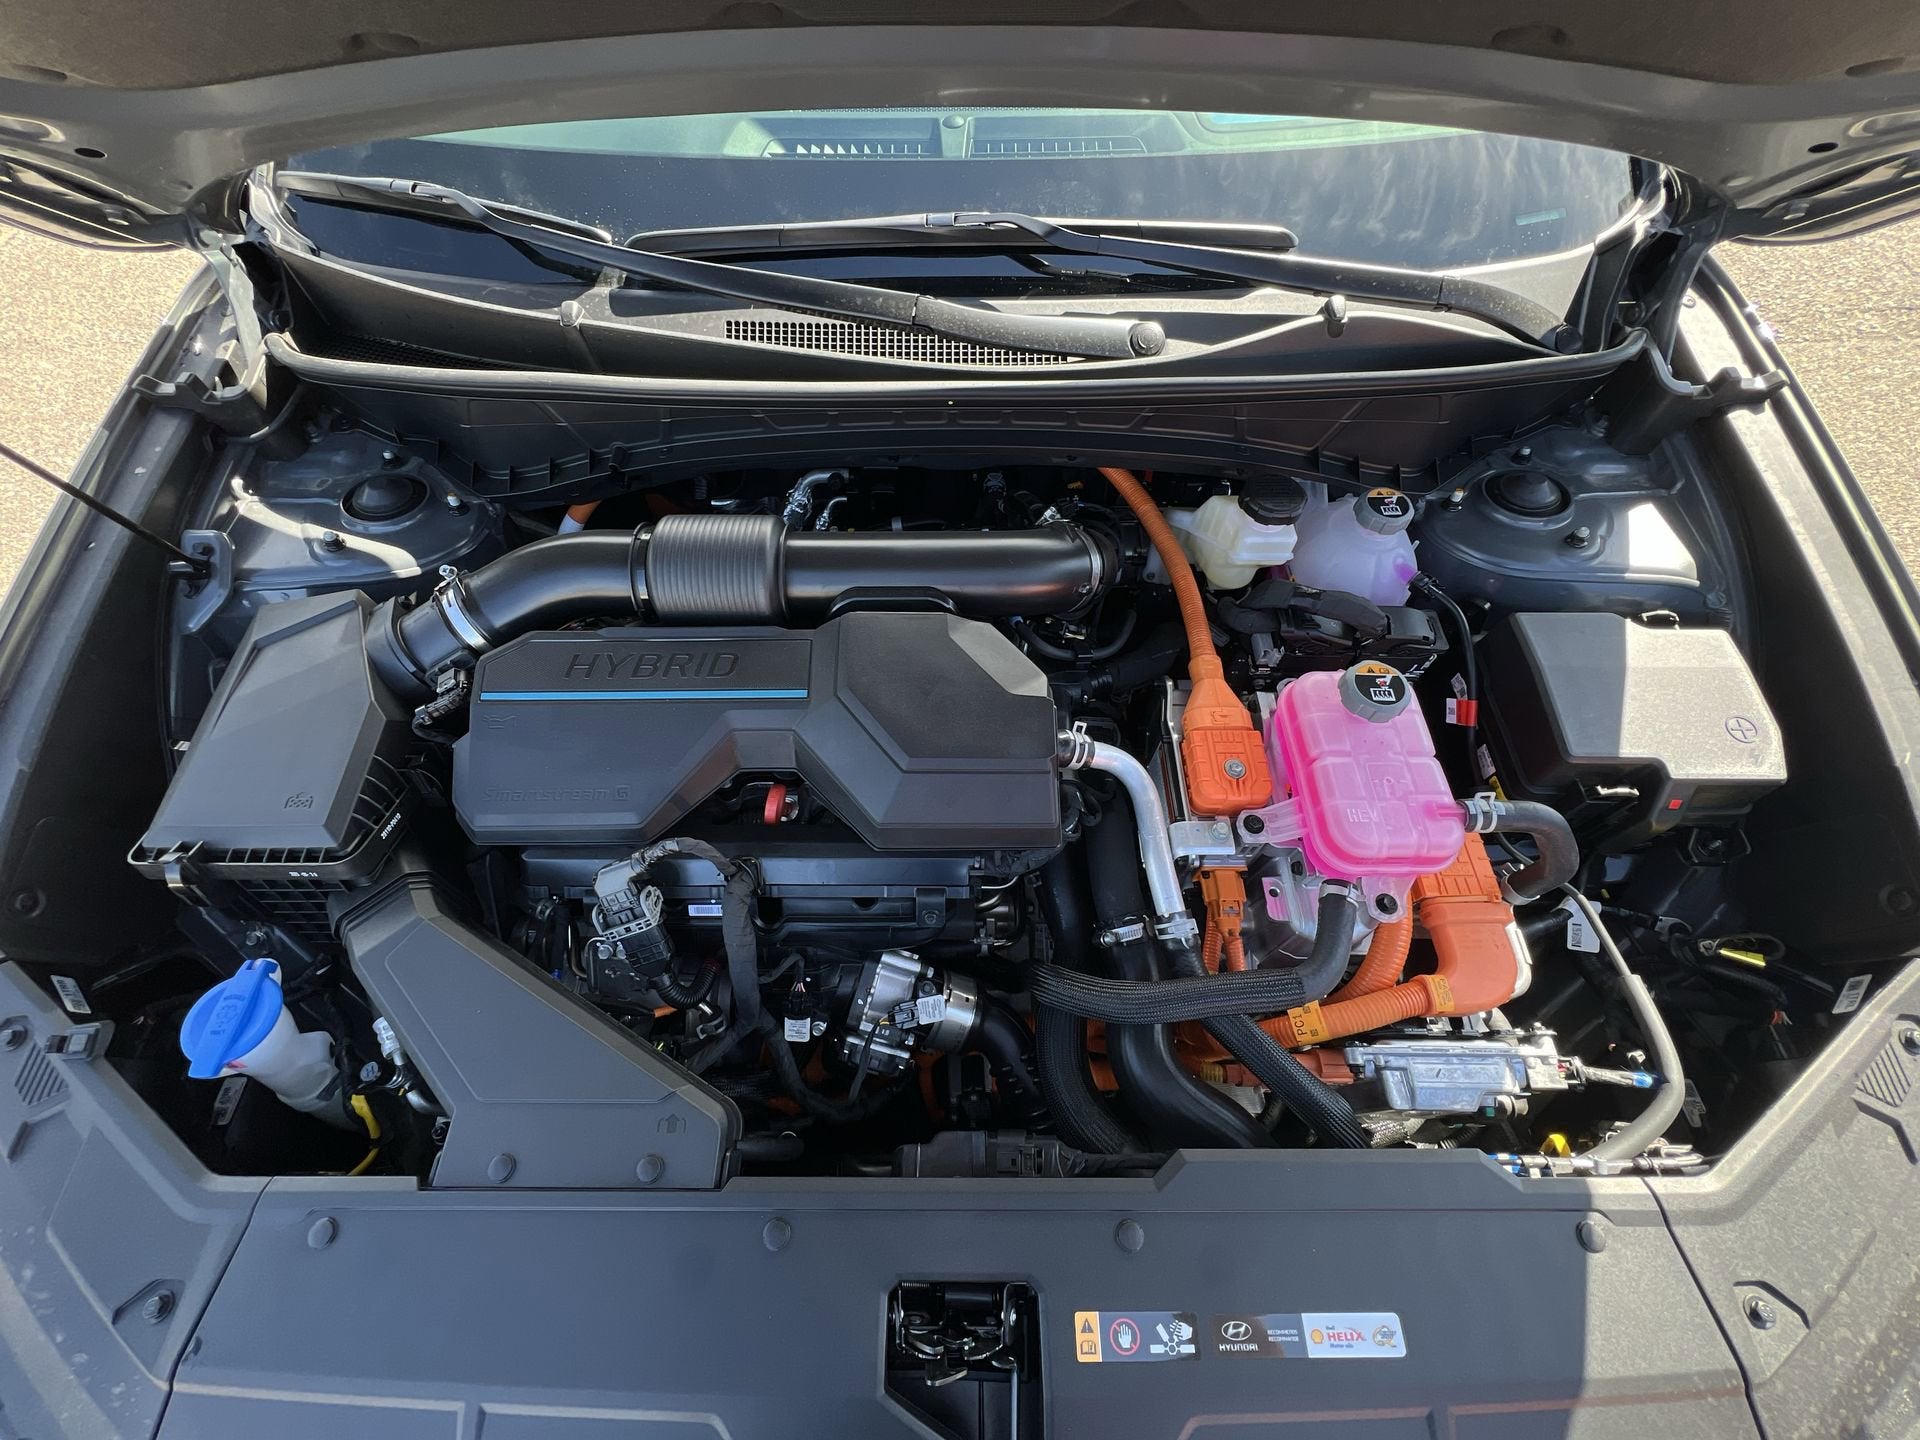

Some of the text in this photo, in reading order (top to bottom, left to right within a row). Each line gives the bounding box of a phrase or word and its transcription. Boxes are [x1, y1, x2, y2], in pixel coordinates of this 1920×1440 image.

[563, 652, 741, 680] HYBRID
[483, 783, 632, 801] Smartstream G
[1346, 808, 1378, 822] HEV
[1326, 1331, 1365, 1342] HELIX
[1219, 1343, 1259, 1352] HYUNDAI
